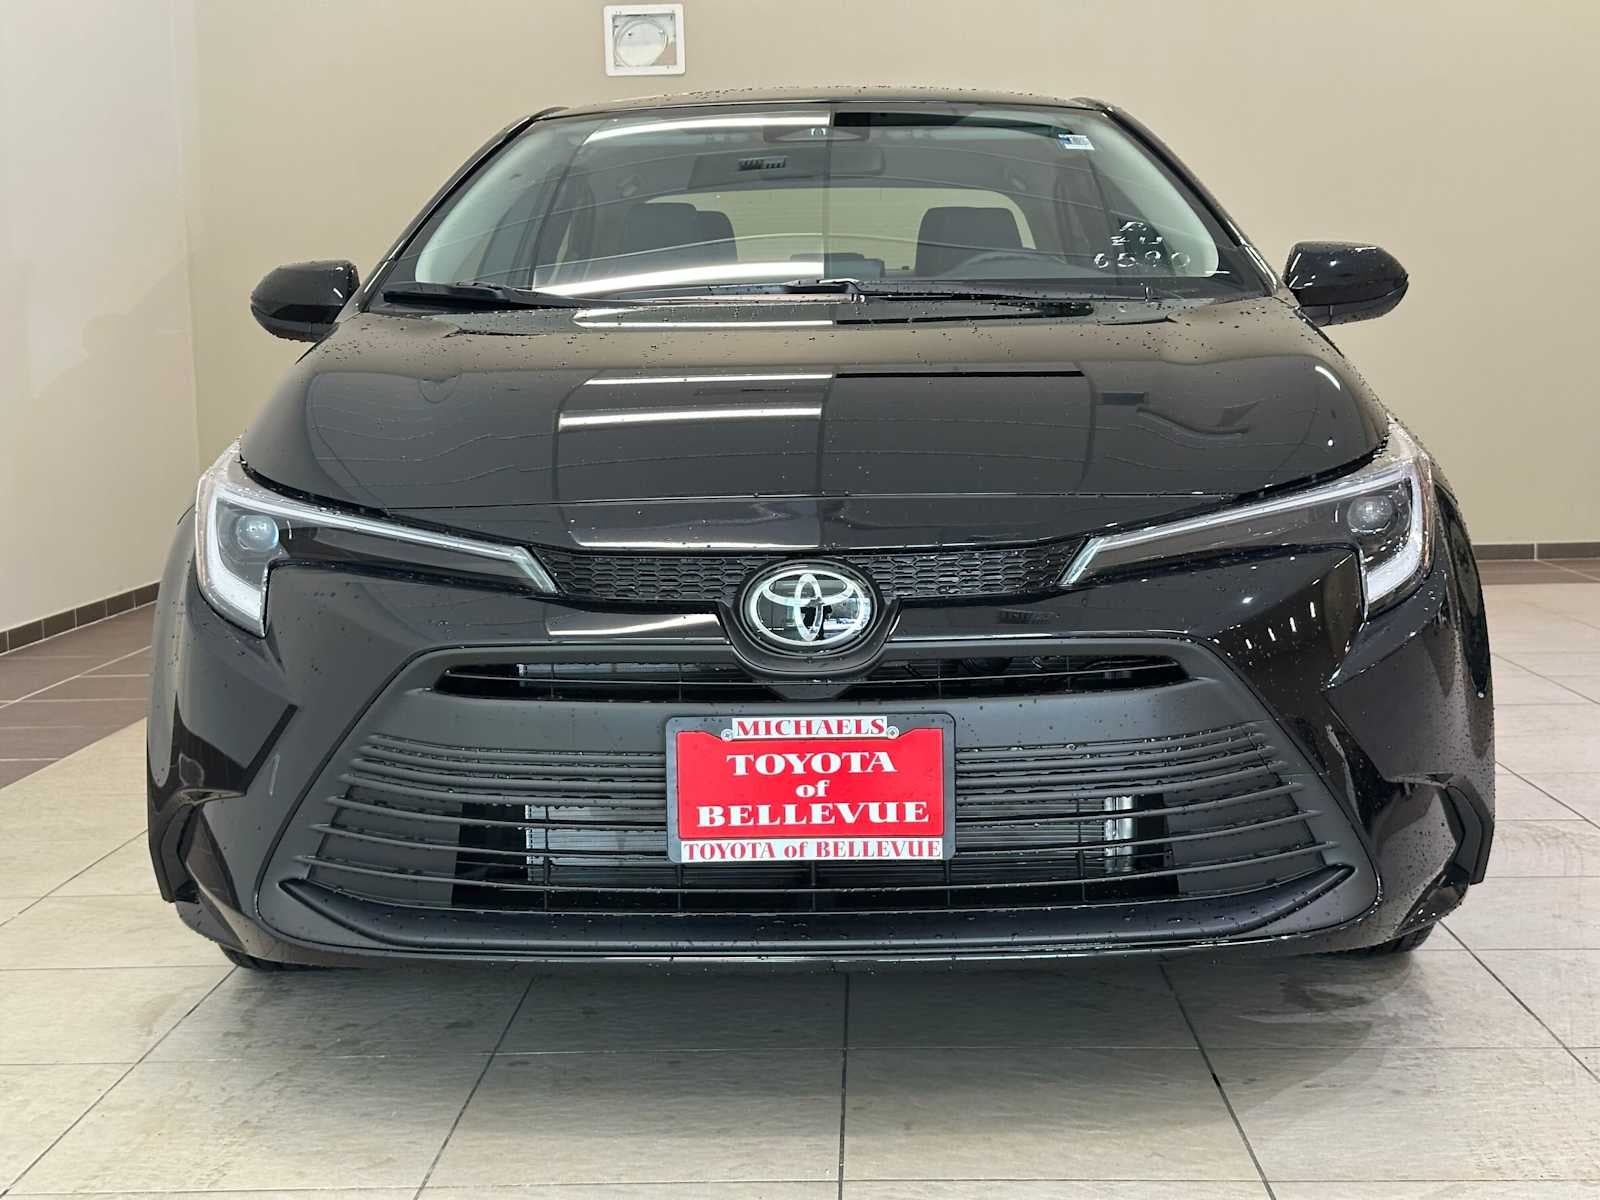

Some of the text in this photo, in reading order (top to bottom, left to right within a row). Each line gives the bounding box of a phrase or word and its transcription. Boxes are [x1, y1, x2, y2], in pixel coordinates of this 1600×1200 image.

[737, 719, 885, 736] MICHAELS
[726, 752, 897, 776] TOYOTA
[795, 780, 830, 798] of
[697, 801, 929, 828] BELLEVUE
[684, 840, 941, 860] TOYOTA of BELLEVUE
